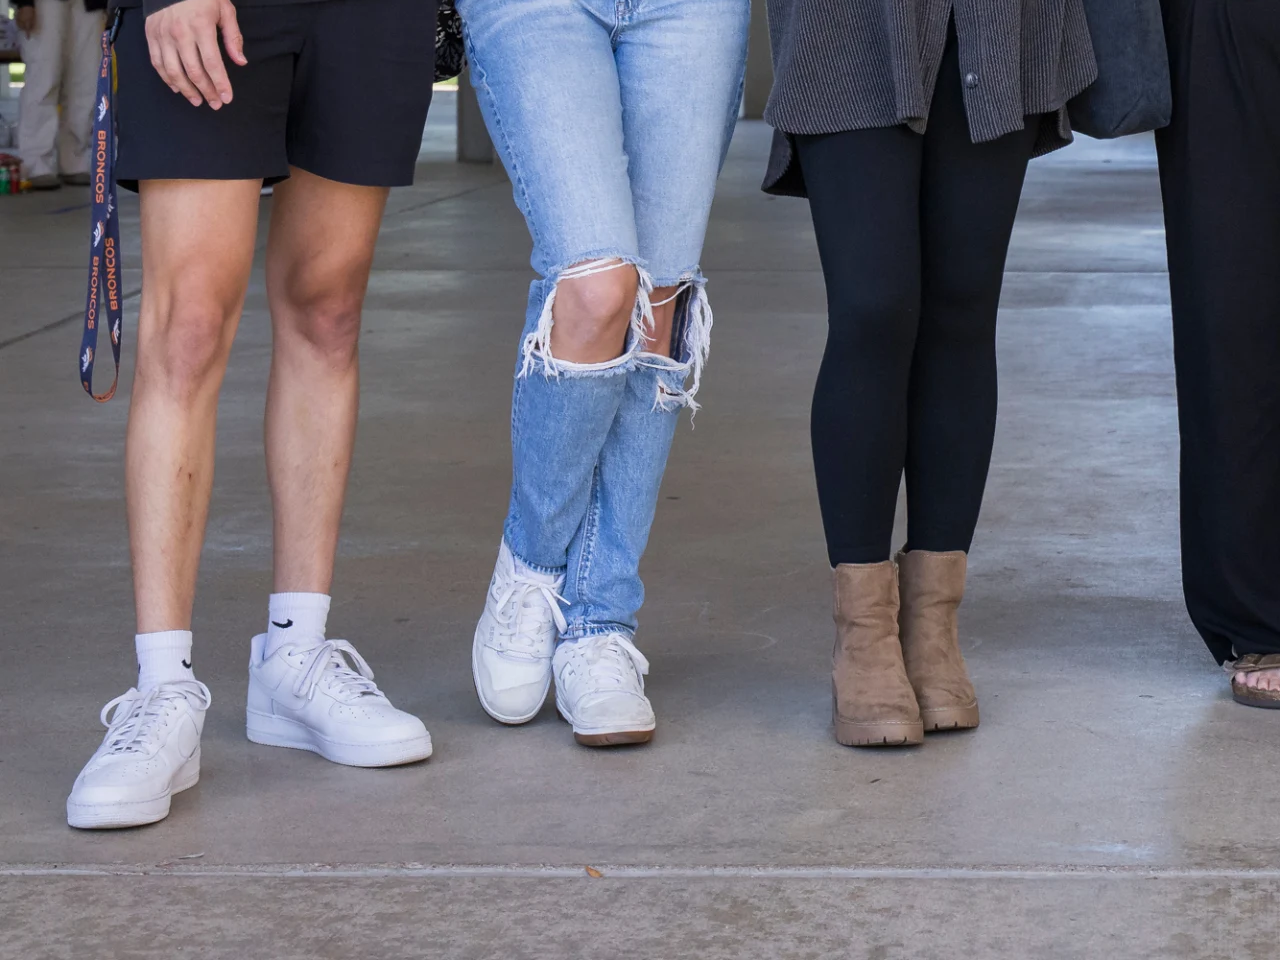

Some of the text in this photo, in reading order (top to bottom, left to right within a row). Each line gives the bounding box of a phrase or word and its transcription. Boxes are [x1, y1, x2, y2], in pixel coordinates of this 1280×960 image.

[95, 130, 106, 204] BRONCOS
[87, 255, 100, 330] BRONCOS
[104, 237, 119, 311] BRONCOS
